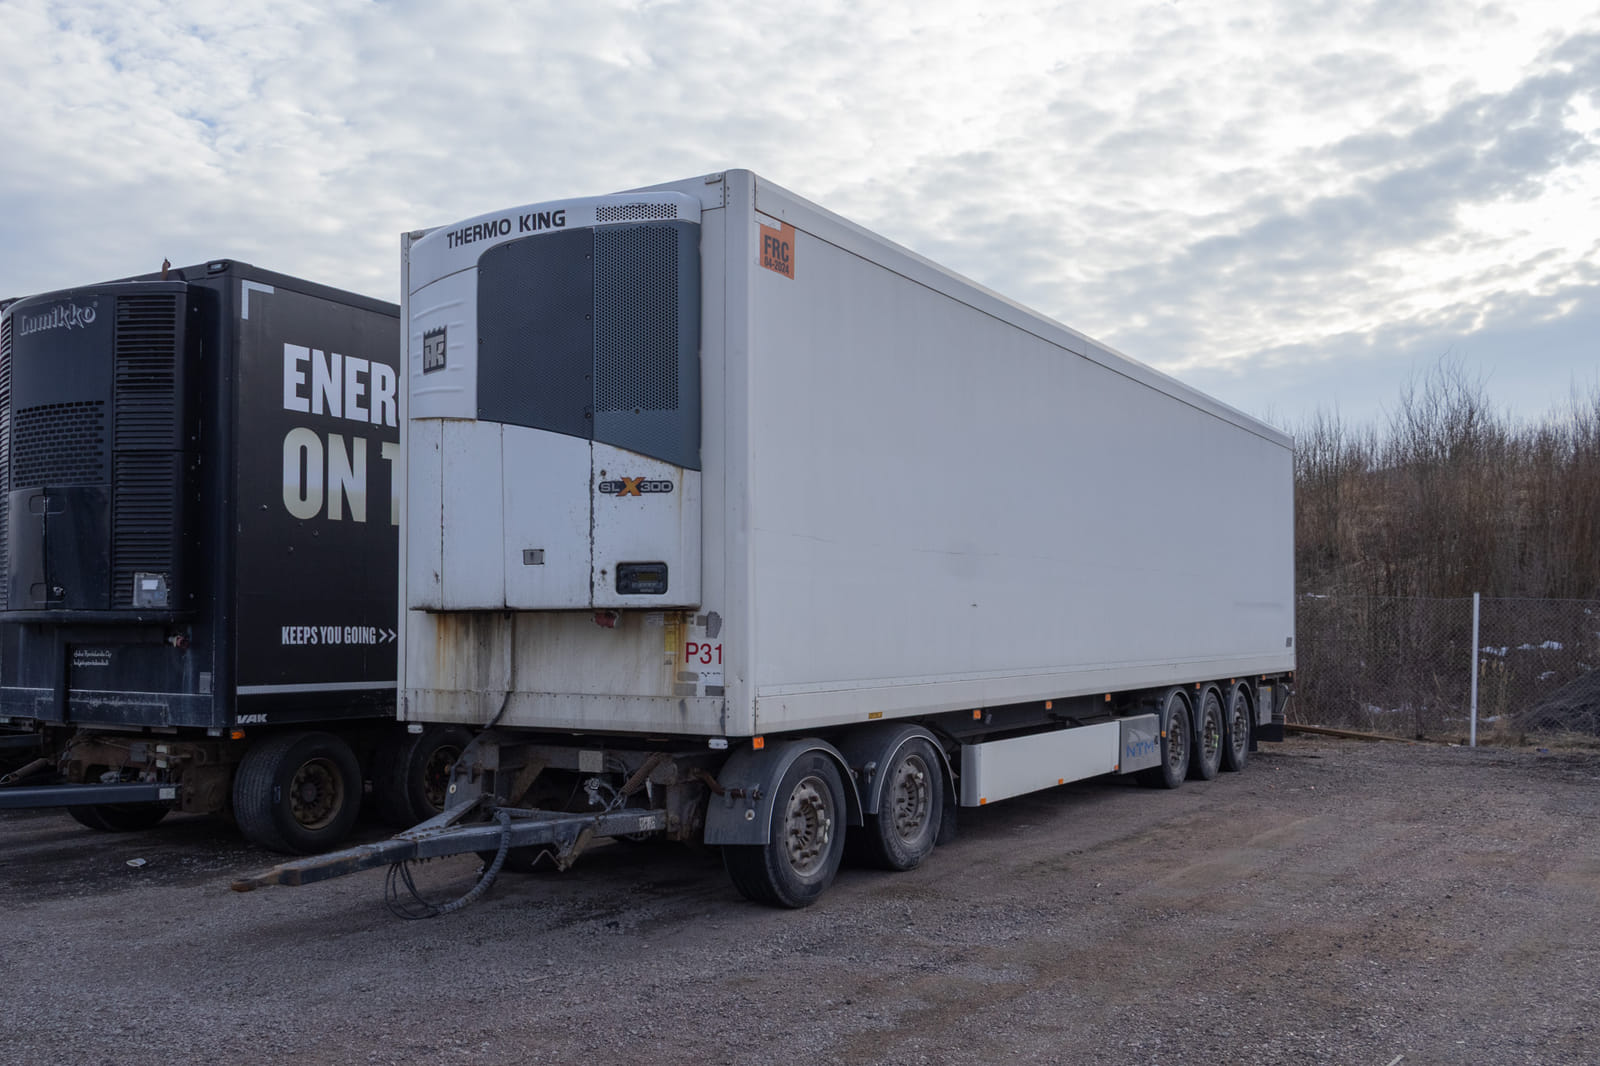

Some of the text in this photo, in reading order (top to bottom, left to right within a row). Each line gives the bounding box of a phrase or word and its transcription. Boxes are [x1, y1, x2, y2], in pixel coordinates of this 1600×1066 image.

[447, 210, 566, 249] THERMO KING
[764, 234, 789, 263] FRC
[20, 303, 96, 336] Lumikko
[283, 342, 401, 428] ENER
[283, 427, 367, 523] ON
[599, 476, 674, 497] SLX300
[281, 626, 376, 645] KEEPS YOU GOING
[685, 641, 723, 665] P31
[237, 713, 268, 724] VAK
[1126, 739, 1155, 759] NTM
